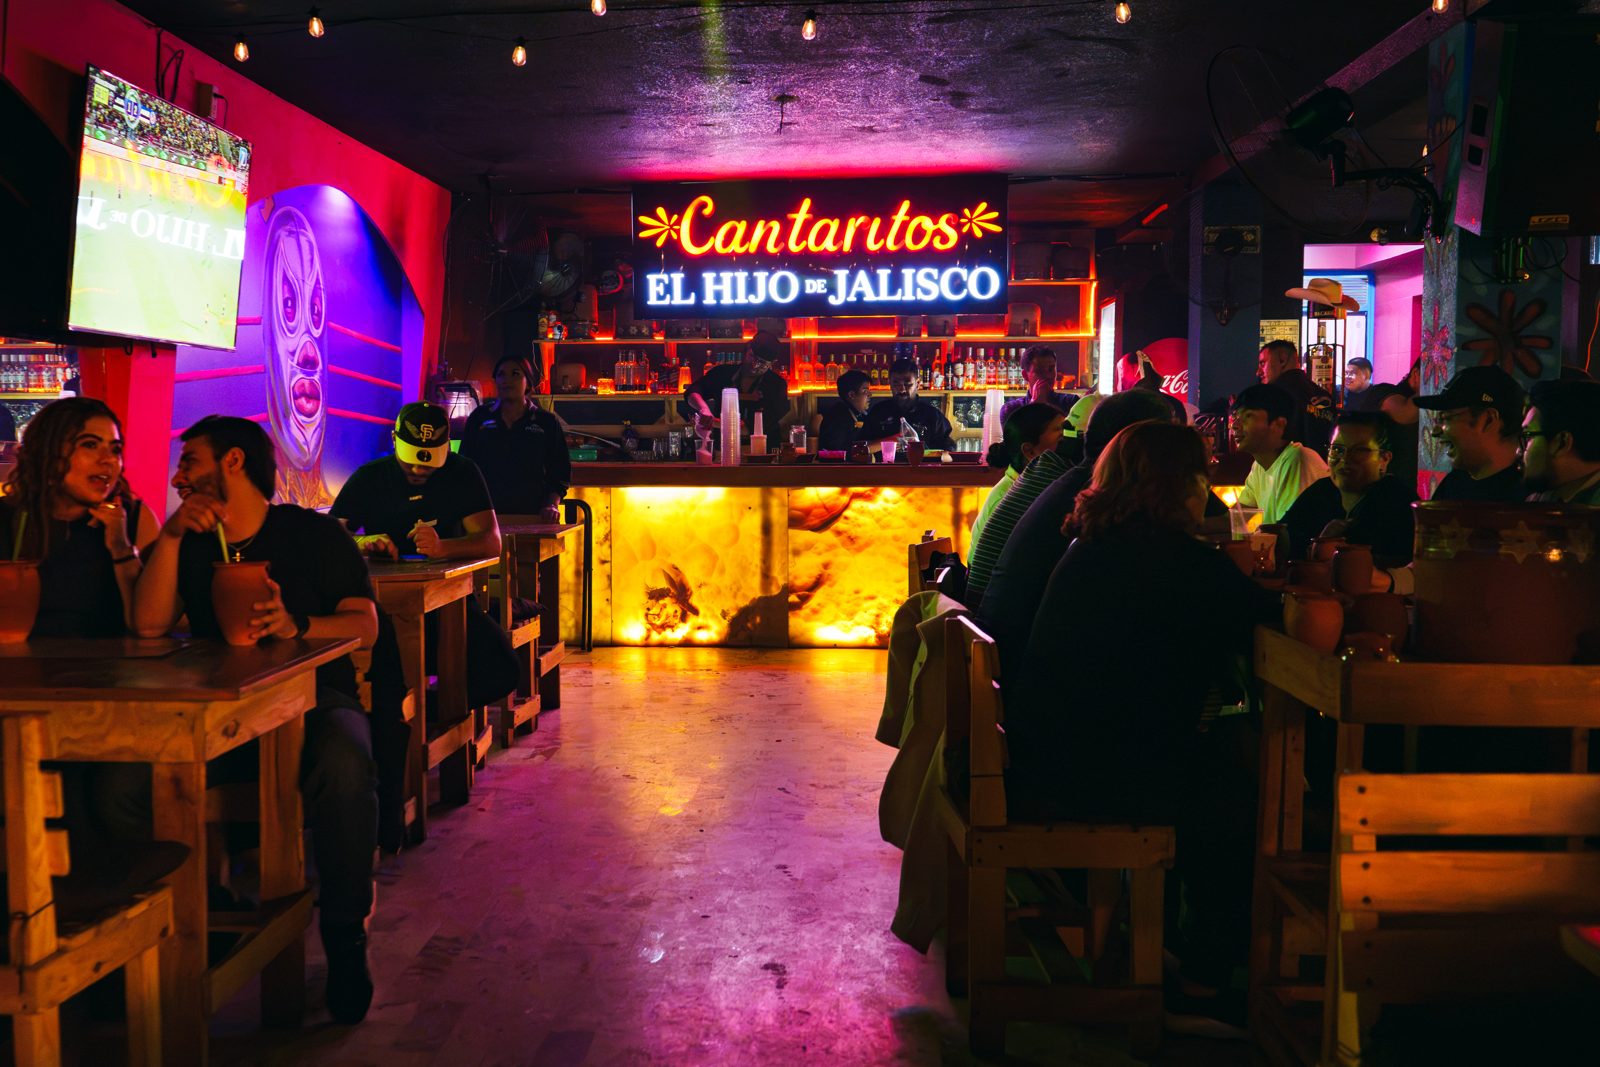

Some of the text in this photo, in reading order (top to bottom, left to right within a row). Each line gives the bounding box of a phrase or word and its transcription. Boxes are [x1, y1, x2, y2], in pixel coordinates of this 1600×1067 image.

[678, 195, 960, 256] Cantaritos
[646, 266, 1000, 305] EL HIJO DE JALISCO
[419, 423, 435, 442] SF
